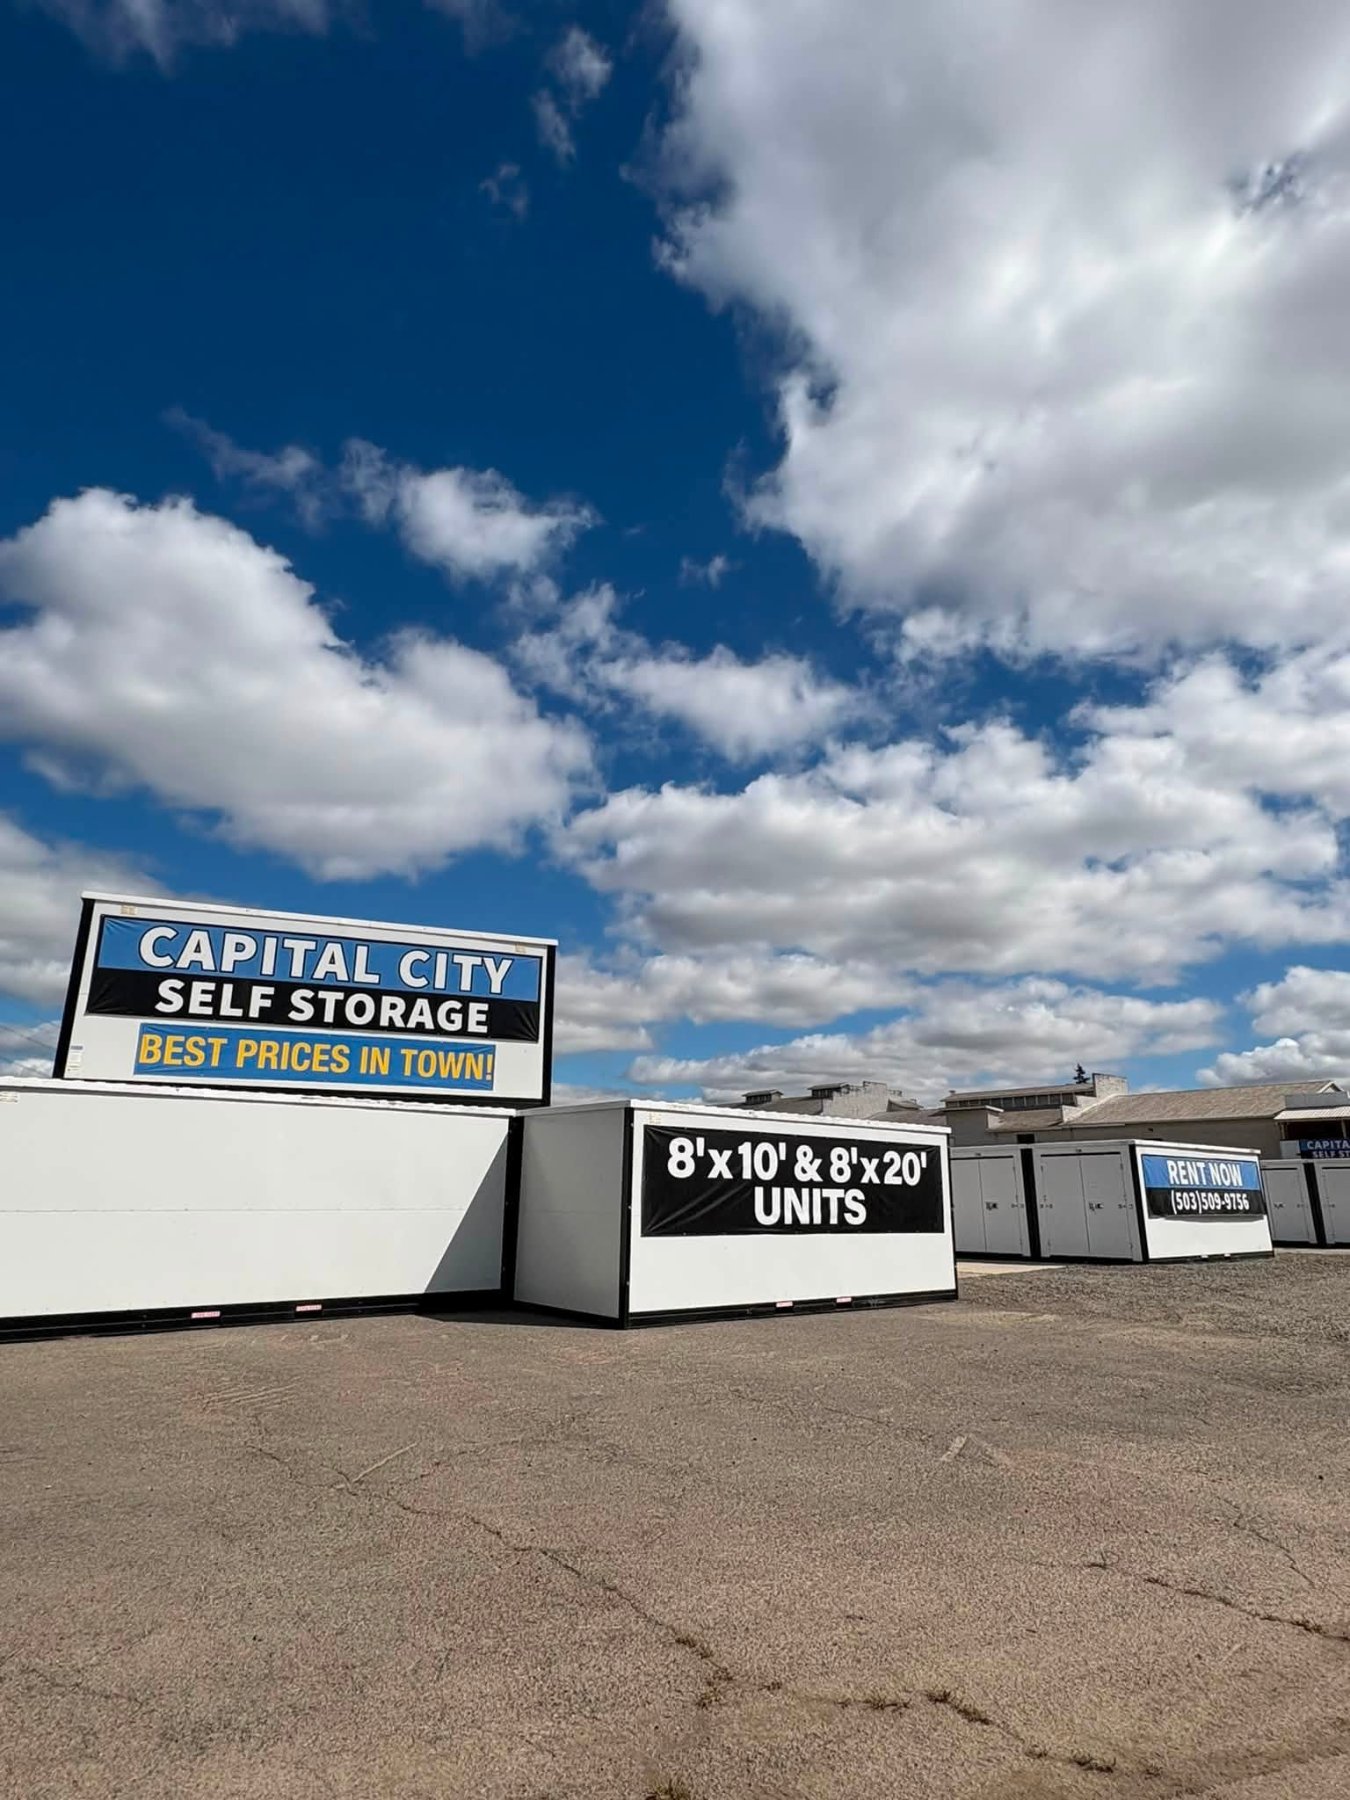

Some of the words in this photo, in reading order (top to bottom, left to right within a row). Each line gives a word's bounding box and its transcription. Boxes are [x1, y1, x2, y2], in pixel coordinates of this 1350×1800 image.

[140, 926, 380, 984] CAPITAL
[400, 951, 512, 994] CITY
[154, 979, 275, 1018] SELF
[288, 989, 489, 1033] STORAGE
[139, 1035, 227, 1066] BEST
[236, 1040, 350, 1074] PRICES
[360, 1046, 391, 1076] IN
[401, 1049, 495, 1081] TOWN!
[794, 1144, 823, 1183] &
[1166, 1160, 1206, 1186] RENT
[1210, 1163, 1243, 1187] NOW
[754, 1186, 867, 1226] UNITS
